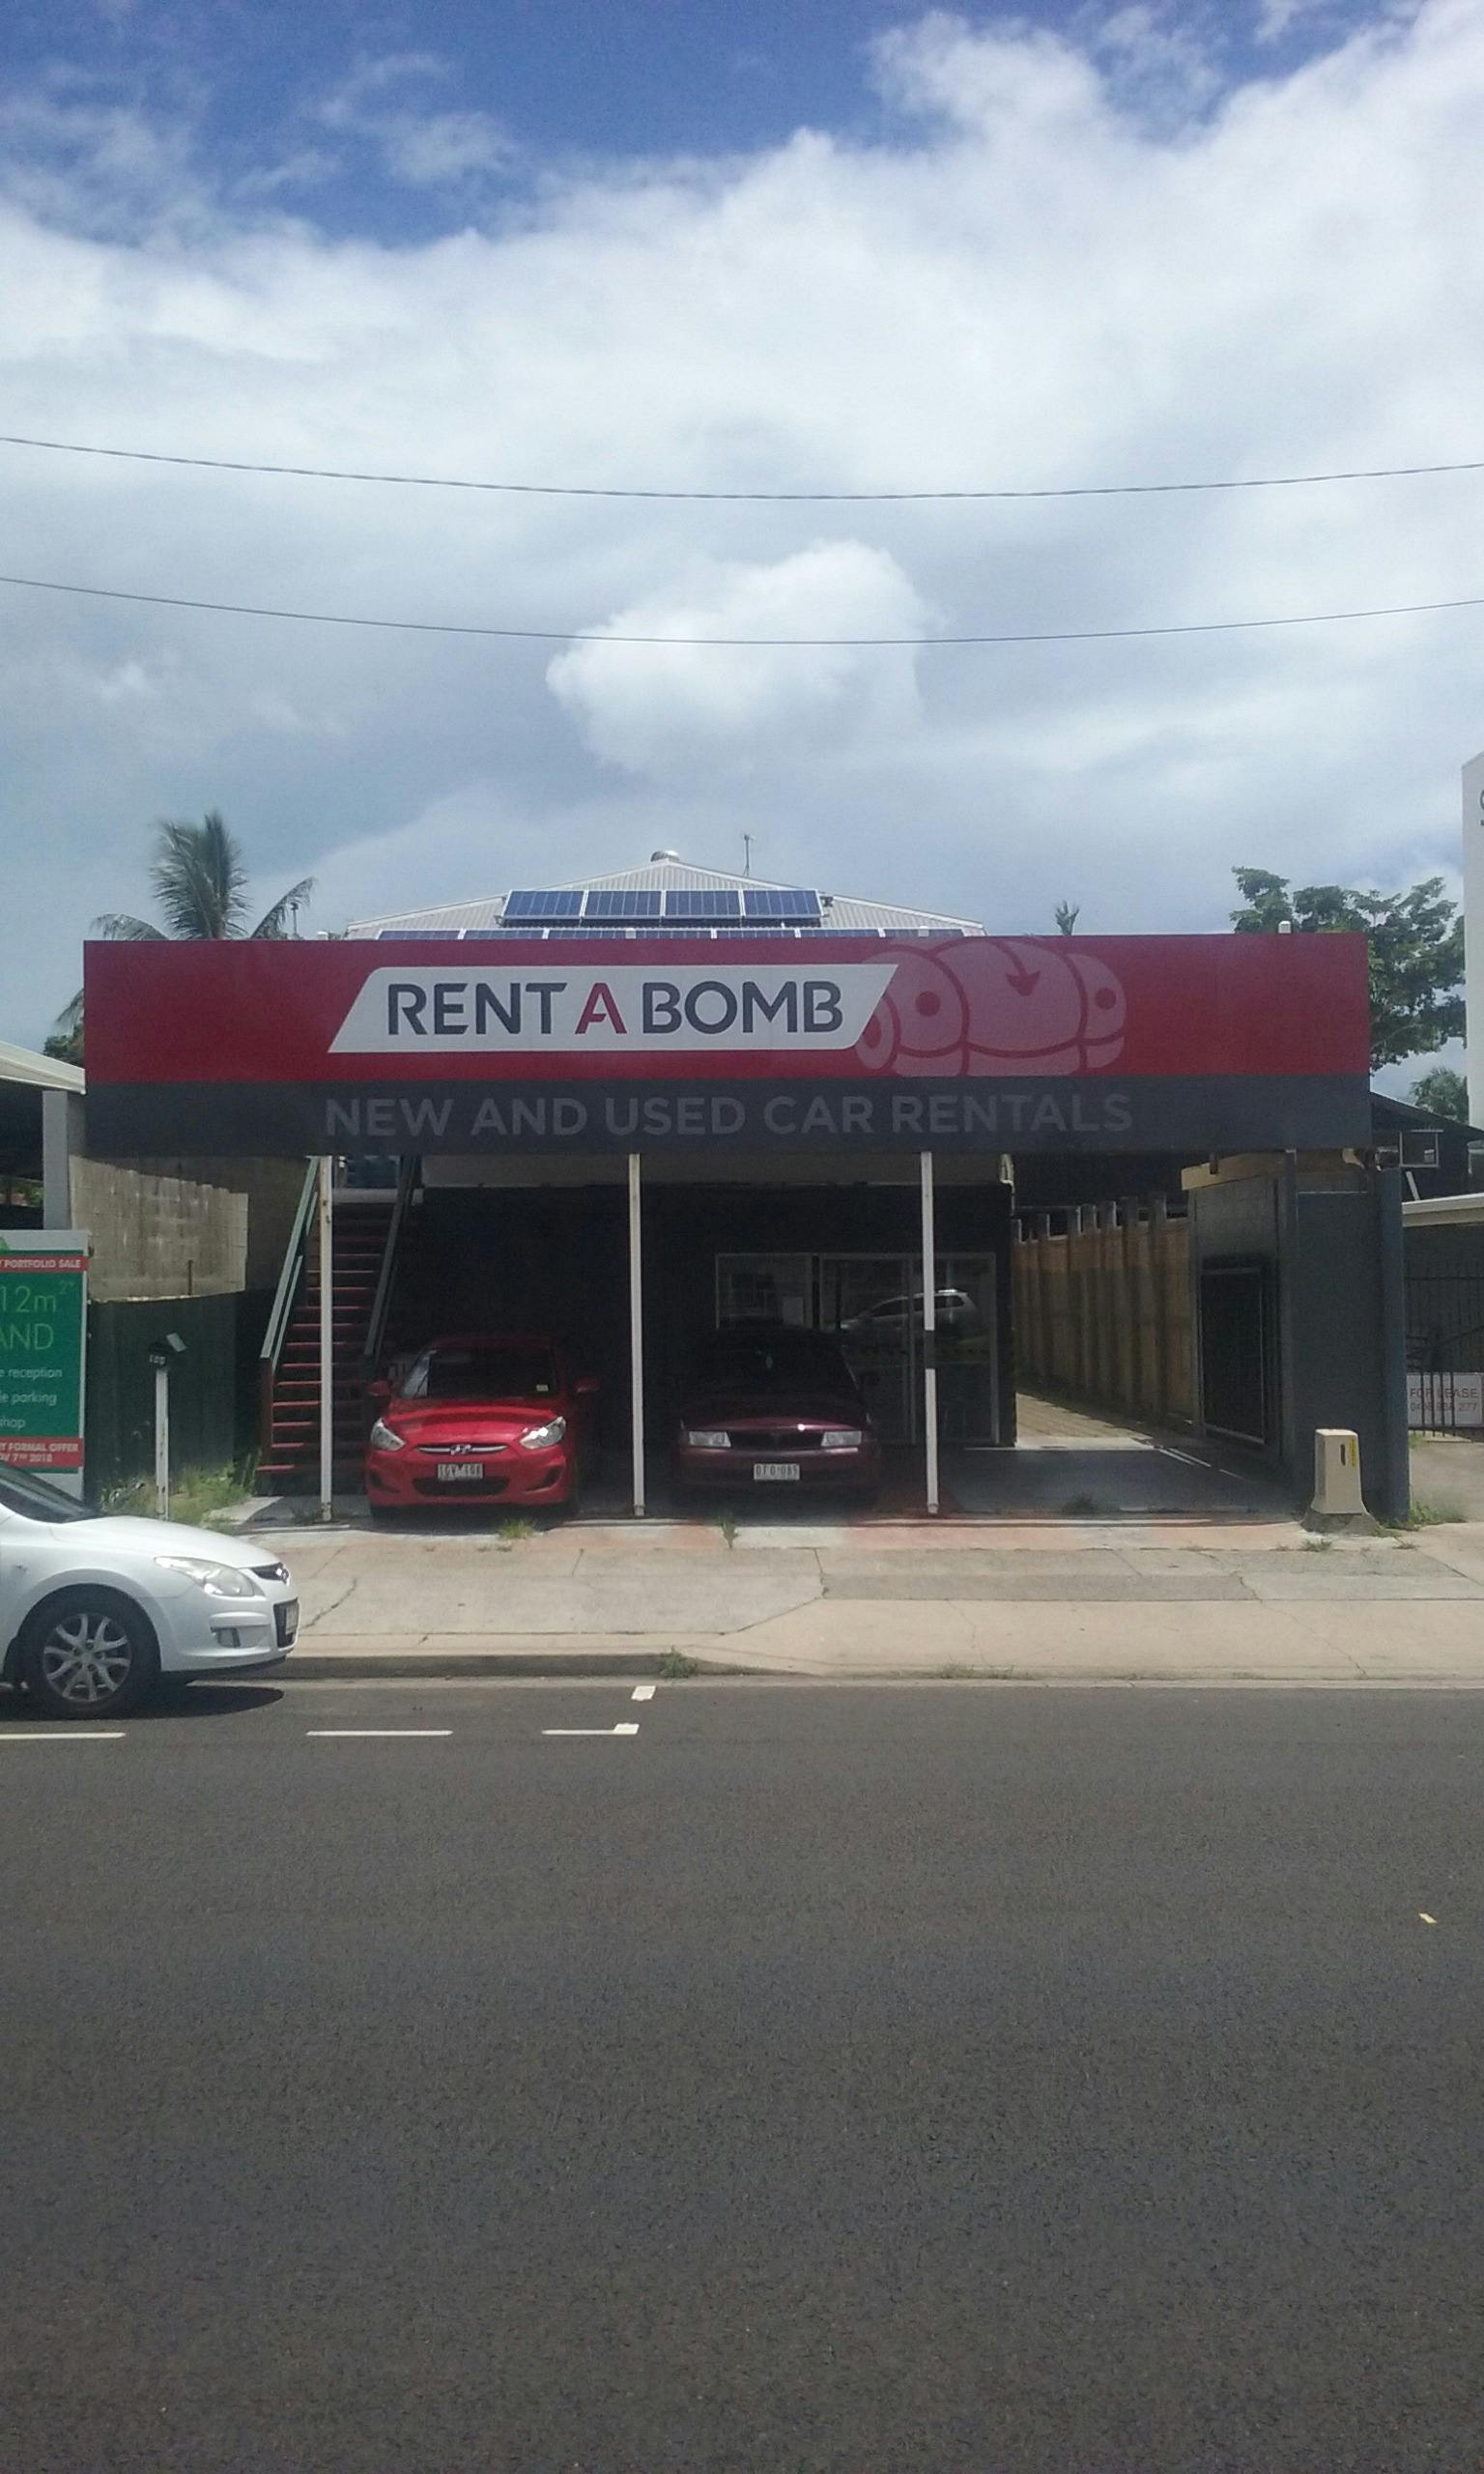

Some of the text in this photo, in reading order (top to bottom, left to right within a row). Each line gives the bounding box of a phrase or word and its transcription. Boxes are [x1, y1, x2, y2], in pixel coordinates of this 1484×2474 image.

[388, 980, 842, 1035] RENT A BOMB
[325, 1093, 1133, 1137] NEW AND USED CAR RENTALS
[4, 1259, 82, 1269] PORTFOLIO SALE
[8, 1366, 63, 1381] reception
[12, 1392, 57, 1406] parking
[9, 1442, 47, 1452] FORMAL
[49, 1443, 79, 1452] OFFER
